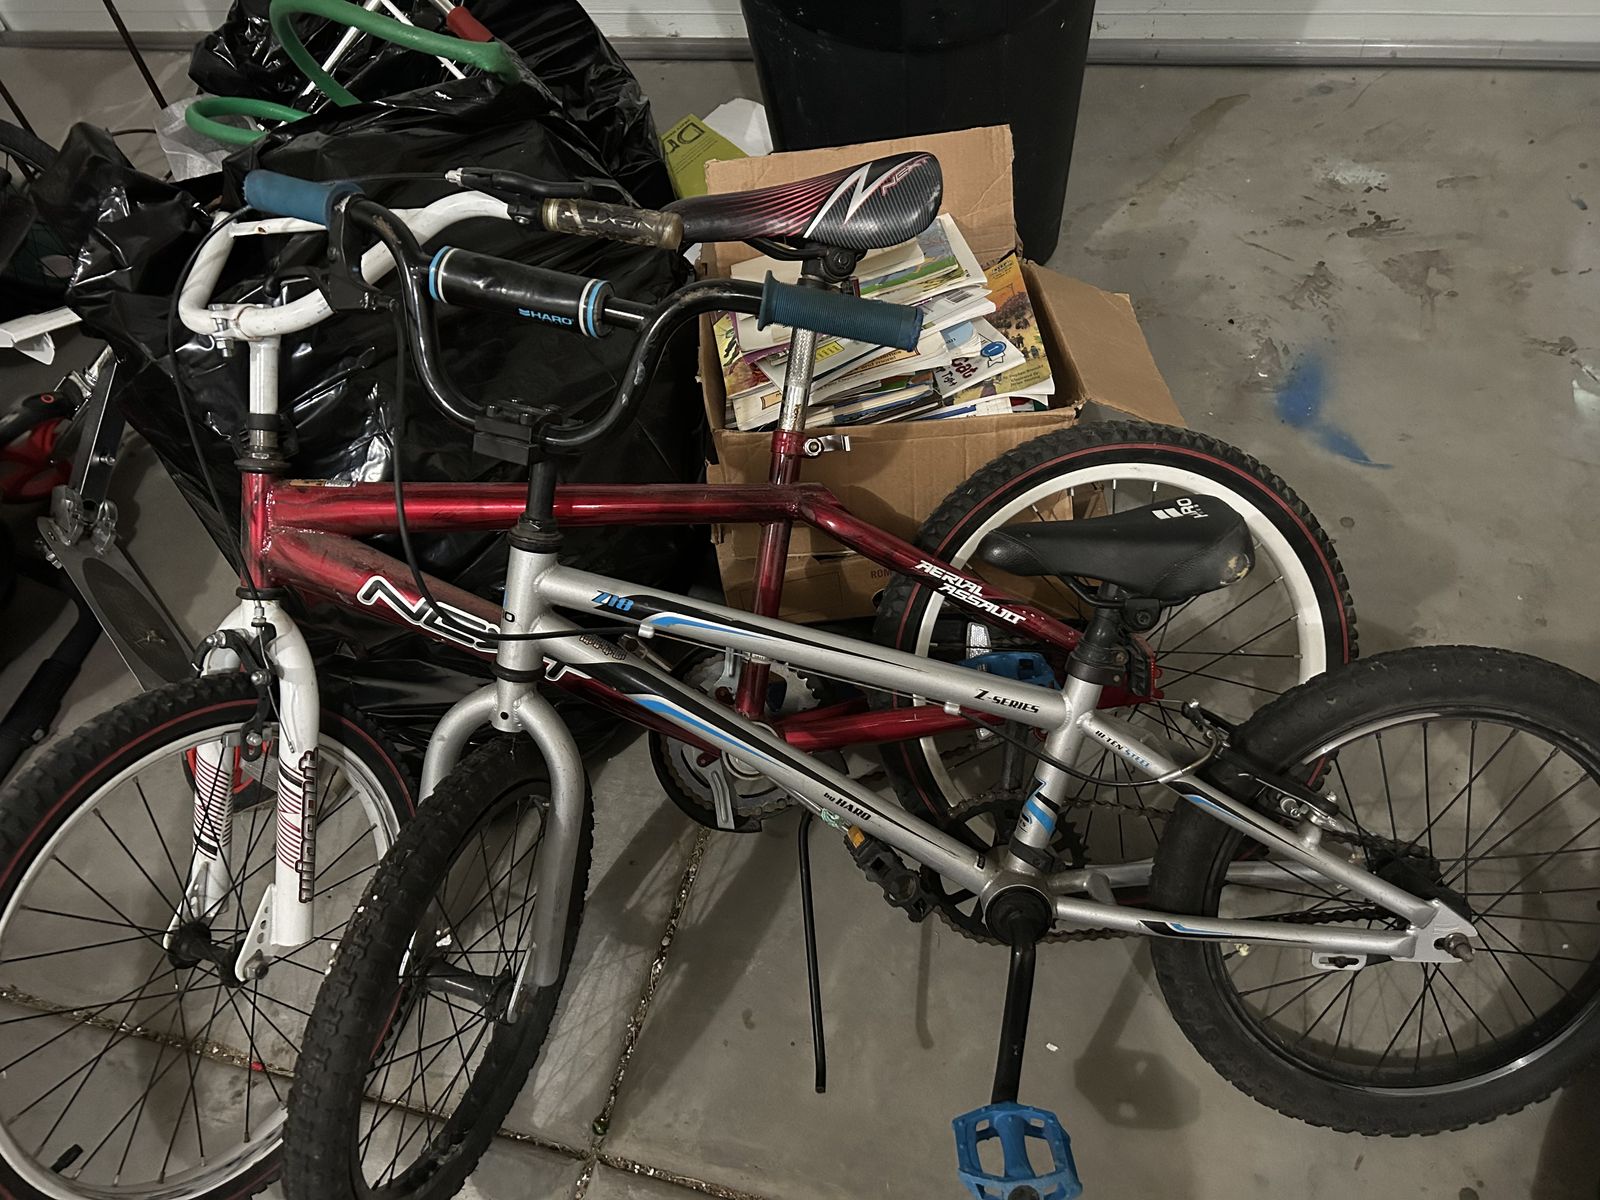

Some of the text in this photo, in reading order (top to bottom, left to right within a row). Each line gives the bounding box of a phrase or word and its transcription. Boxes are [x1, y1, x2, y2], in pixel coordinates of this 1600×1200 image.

[528, 310, 574, 326] HARO
[915, 559, 984, 597] AERIAL
[591, 589, 635, 613] Z18
[938, 582, 1027, 625] ASSAULT
[974, 688, 1041, 714] Z-SERIES
[1095, 729, 1123, 751] HI-TEN
[835, 798, 872, 821] HARO
